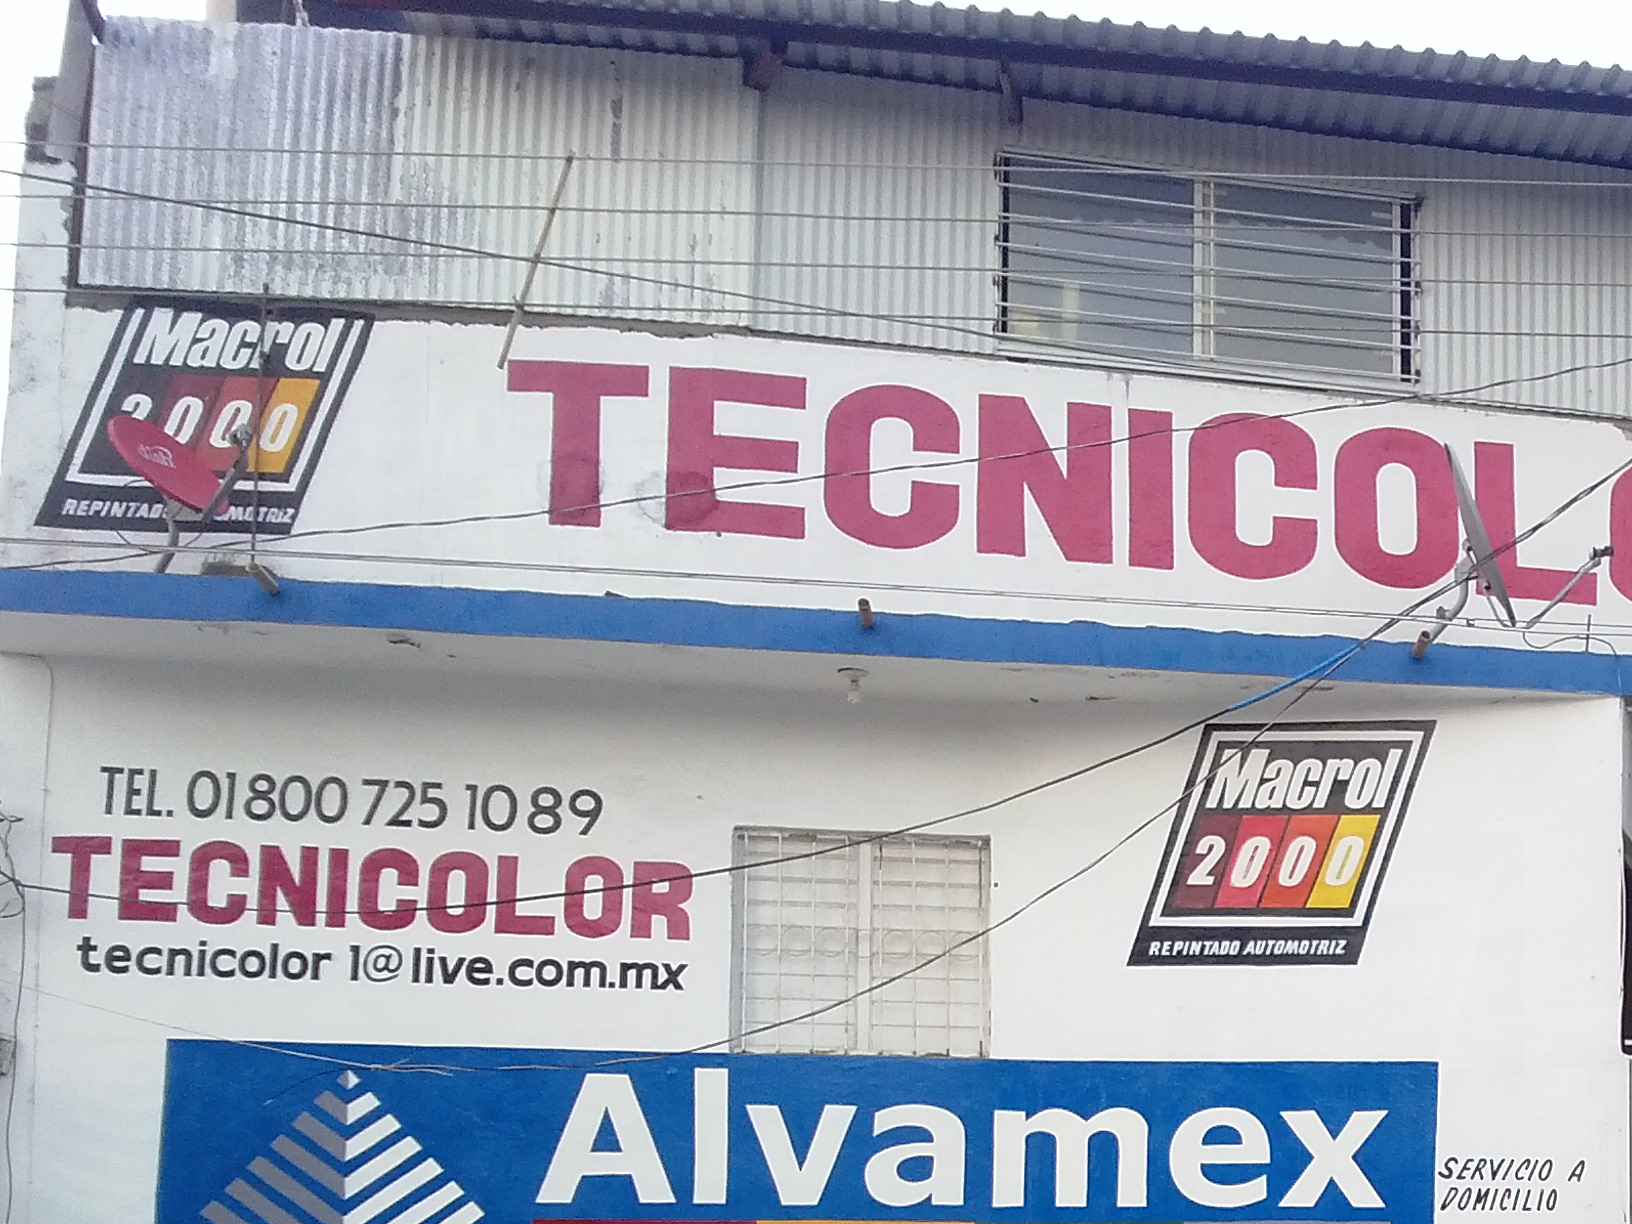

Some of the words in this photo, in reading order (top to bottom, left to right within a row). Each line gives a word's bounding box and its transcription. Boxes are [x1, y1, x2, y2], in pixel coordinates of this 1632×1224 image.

[134, 307, 345, 372] Macrol
[101, 766, 174, 818] TEL.
[361, 779, 448, 828] 725
[1205, 748, 1403, 809] Macrol
[52, 835, 693, 941] TECNICOLOR
[1186, 835, 1365, 888] 2000
[1148, 939, 1241, 957] REPINTADO
[1242, 939, 1348, 956] AUTOMOTRIZ
[536, 1067, 1390, 1209] Alvamex
[1438, 1156, 1553, 1182] SERVICIO
[1567, 1159, 1586, 1182] A
[1440, 1187, 1558, 1212] DOMICILIO
